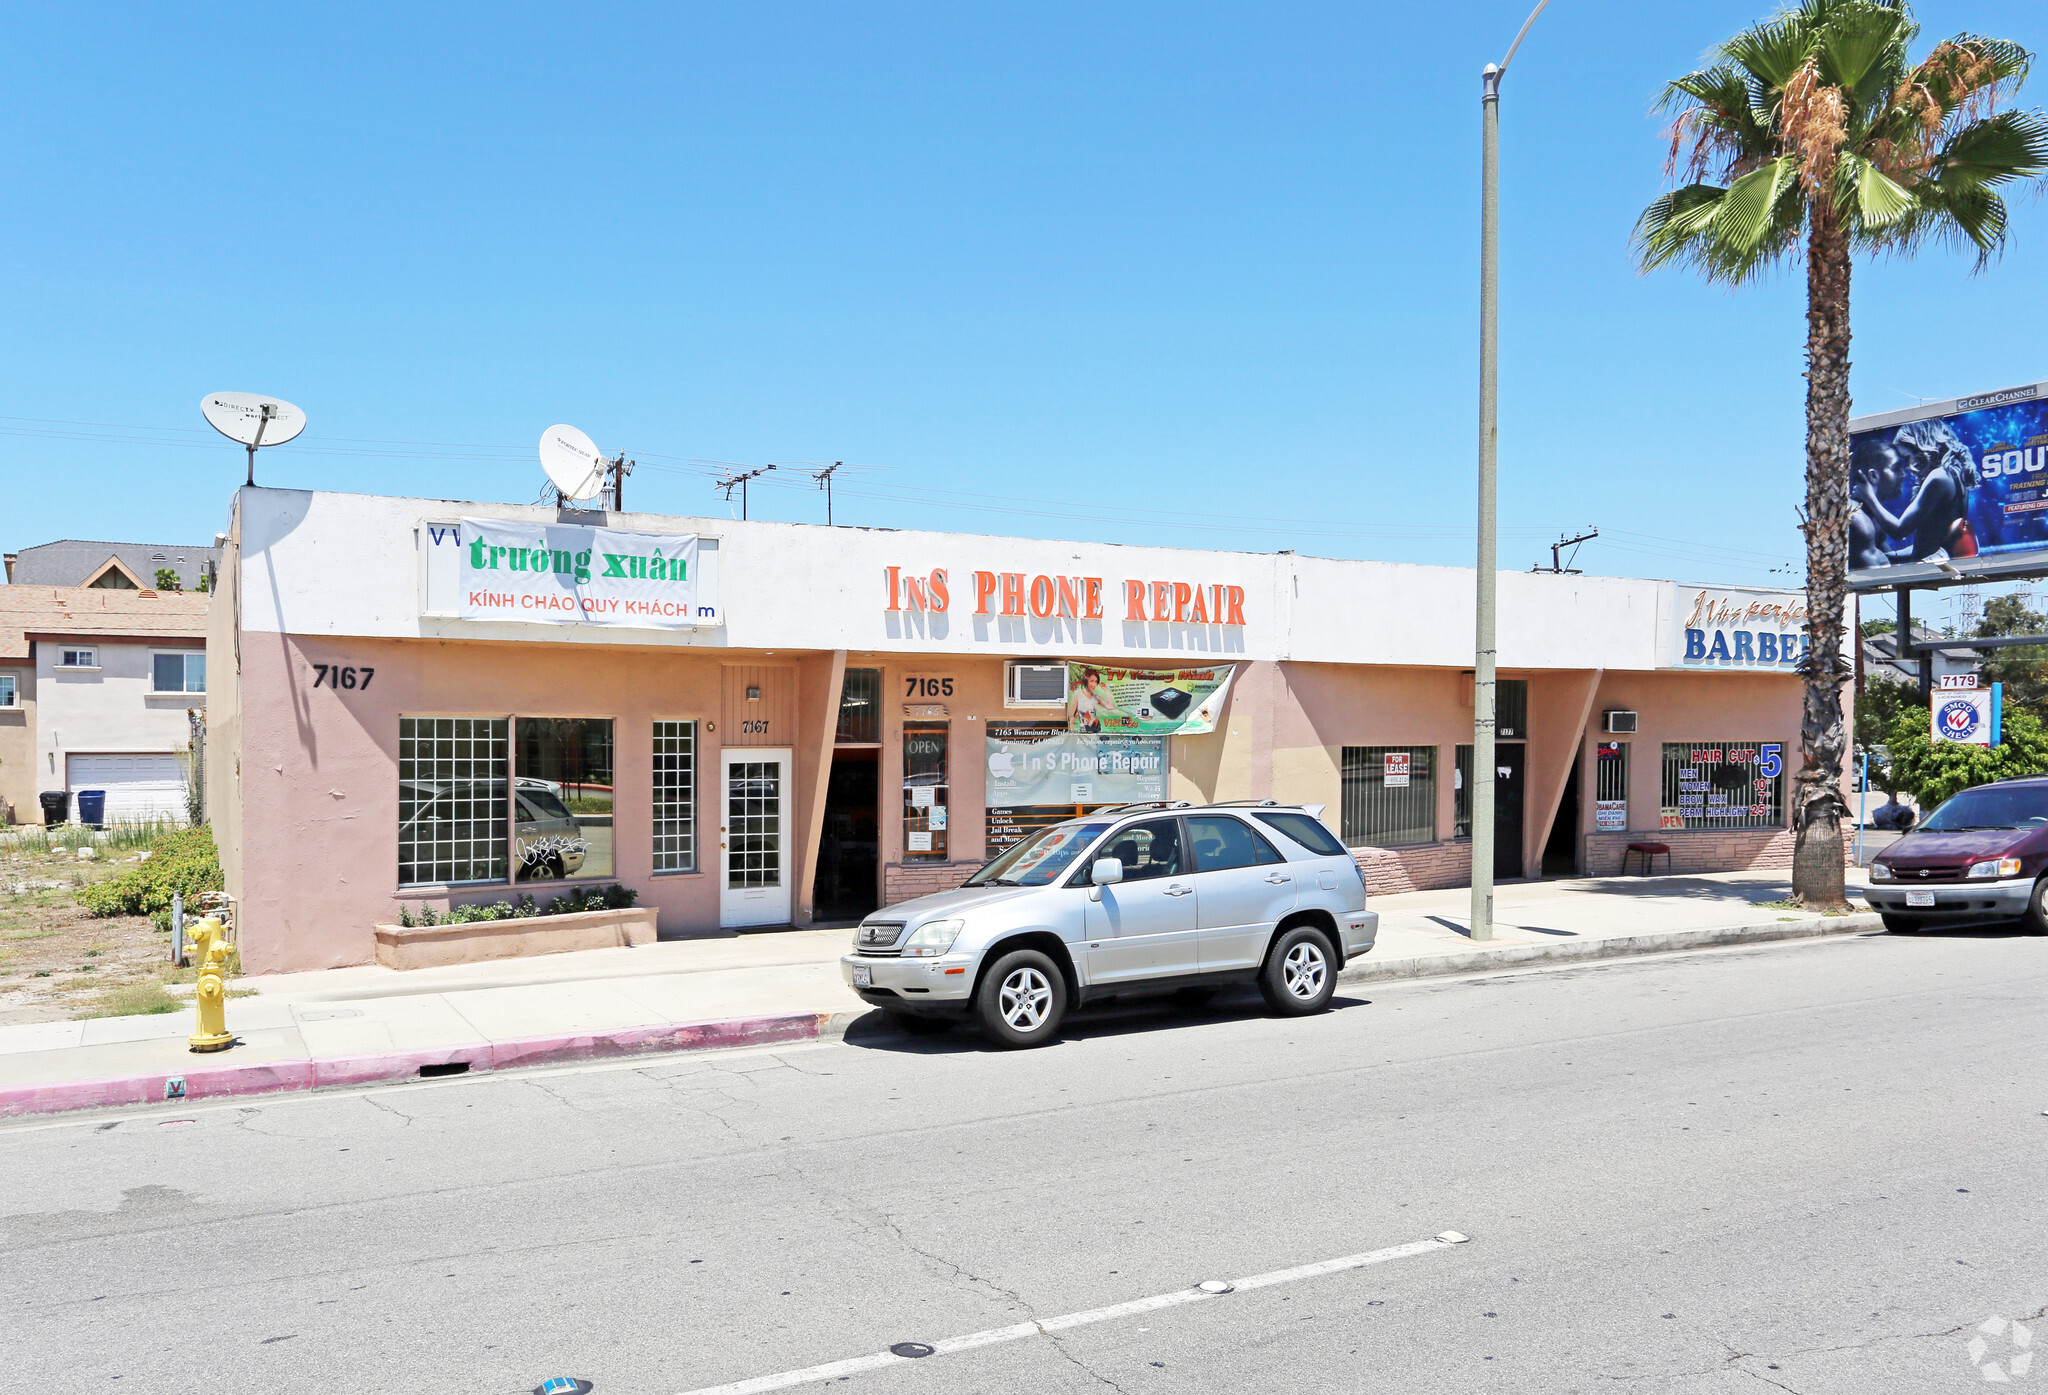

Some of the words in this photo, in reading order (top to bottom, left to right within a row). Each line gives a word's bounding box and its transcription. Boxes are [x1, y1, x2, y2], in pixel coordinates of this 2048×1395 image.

[1982, 446, 2048, 479] SOU
[2009, 480, 2047, 490] TRAINING
[2007, 502, 2036, 511] FEATURING
[468, 535, 592, 585] trường
[601, 547, 689, 582] xuân
[469, 588, 515, 608] KÍNH
[520, 592, 575, 611] CHÀO
[581, 595, 619, 613] QUÝ
[625, 595, 688, 617] KHÁCH
[972, 570, 1104, 619] PHONE
[1122, 579, 1247, 625] REPAIR
[313, 664, 375, 691] 7167
[1106, 669, 1128, 681] TV
[1178, 669, 1215, 681] Minh
[905, 677, 954, 697] 7165
[1942, 676, 1976, 687] 7179
[914, 706, 940, 717] 7165
[1944, 702, 1974, 714] SMOG
[742, 720, 769, 734] 7167
[1942, 725, 1976, 739] CHECK
[908, 740, 940, 754] OPEN
[1691, 749, 1722, 763] HAIR
[1728, 748, 1755, 763] CUT
[1061, 752, 1108, 770] Phone
[1112, 752, 1160, 774] Repair
[1386, 763, 1408, 774] LEASE
[1680, 769, 1698, 778] MEN
[994, 779, 1017, 787] Install:
[1680, 782, 1711, 791] WOMEN
[1680, 794, 1704, 804] BROW
[1708, 794, 1728, 804] WAX
[1758, 792, 1766, 804] 7
[1679, 807, 1703, 817] PERM
[1706, 806, 1749, 817] HIGHLIGHT
[990, 826, 1002, 834] Jail
[1003, 826, 1023, 834] Break
[170, 1081, 182, 1093] V
